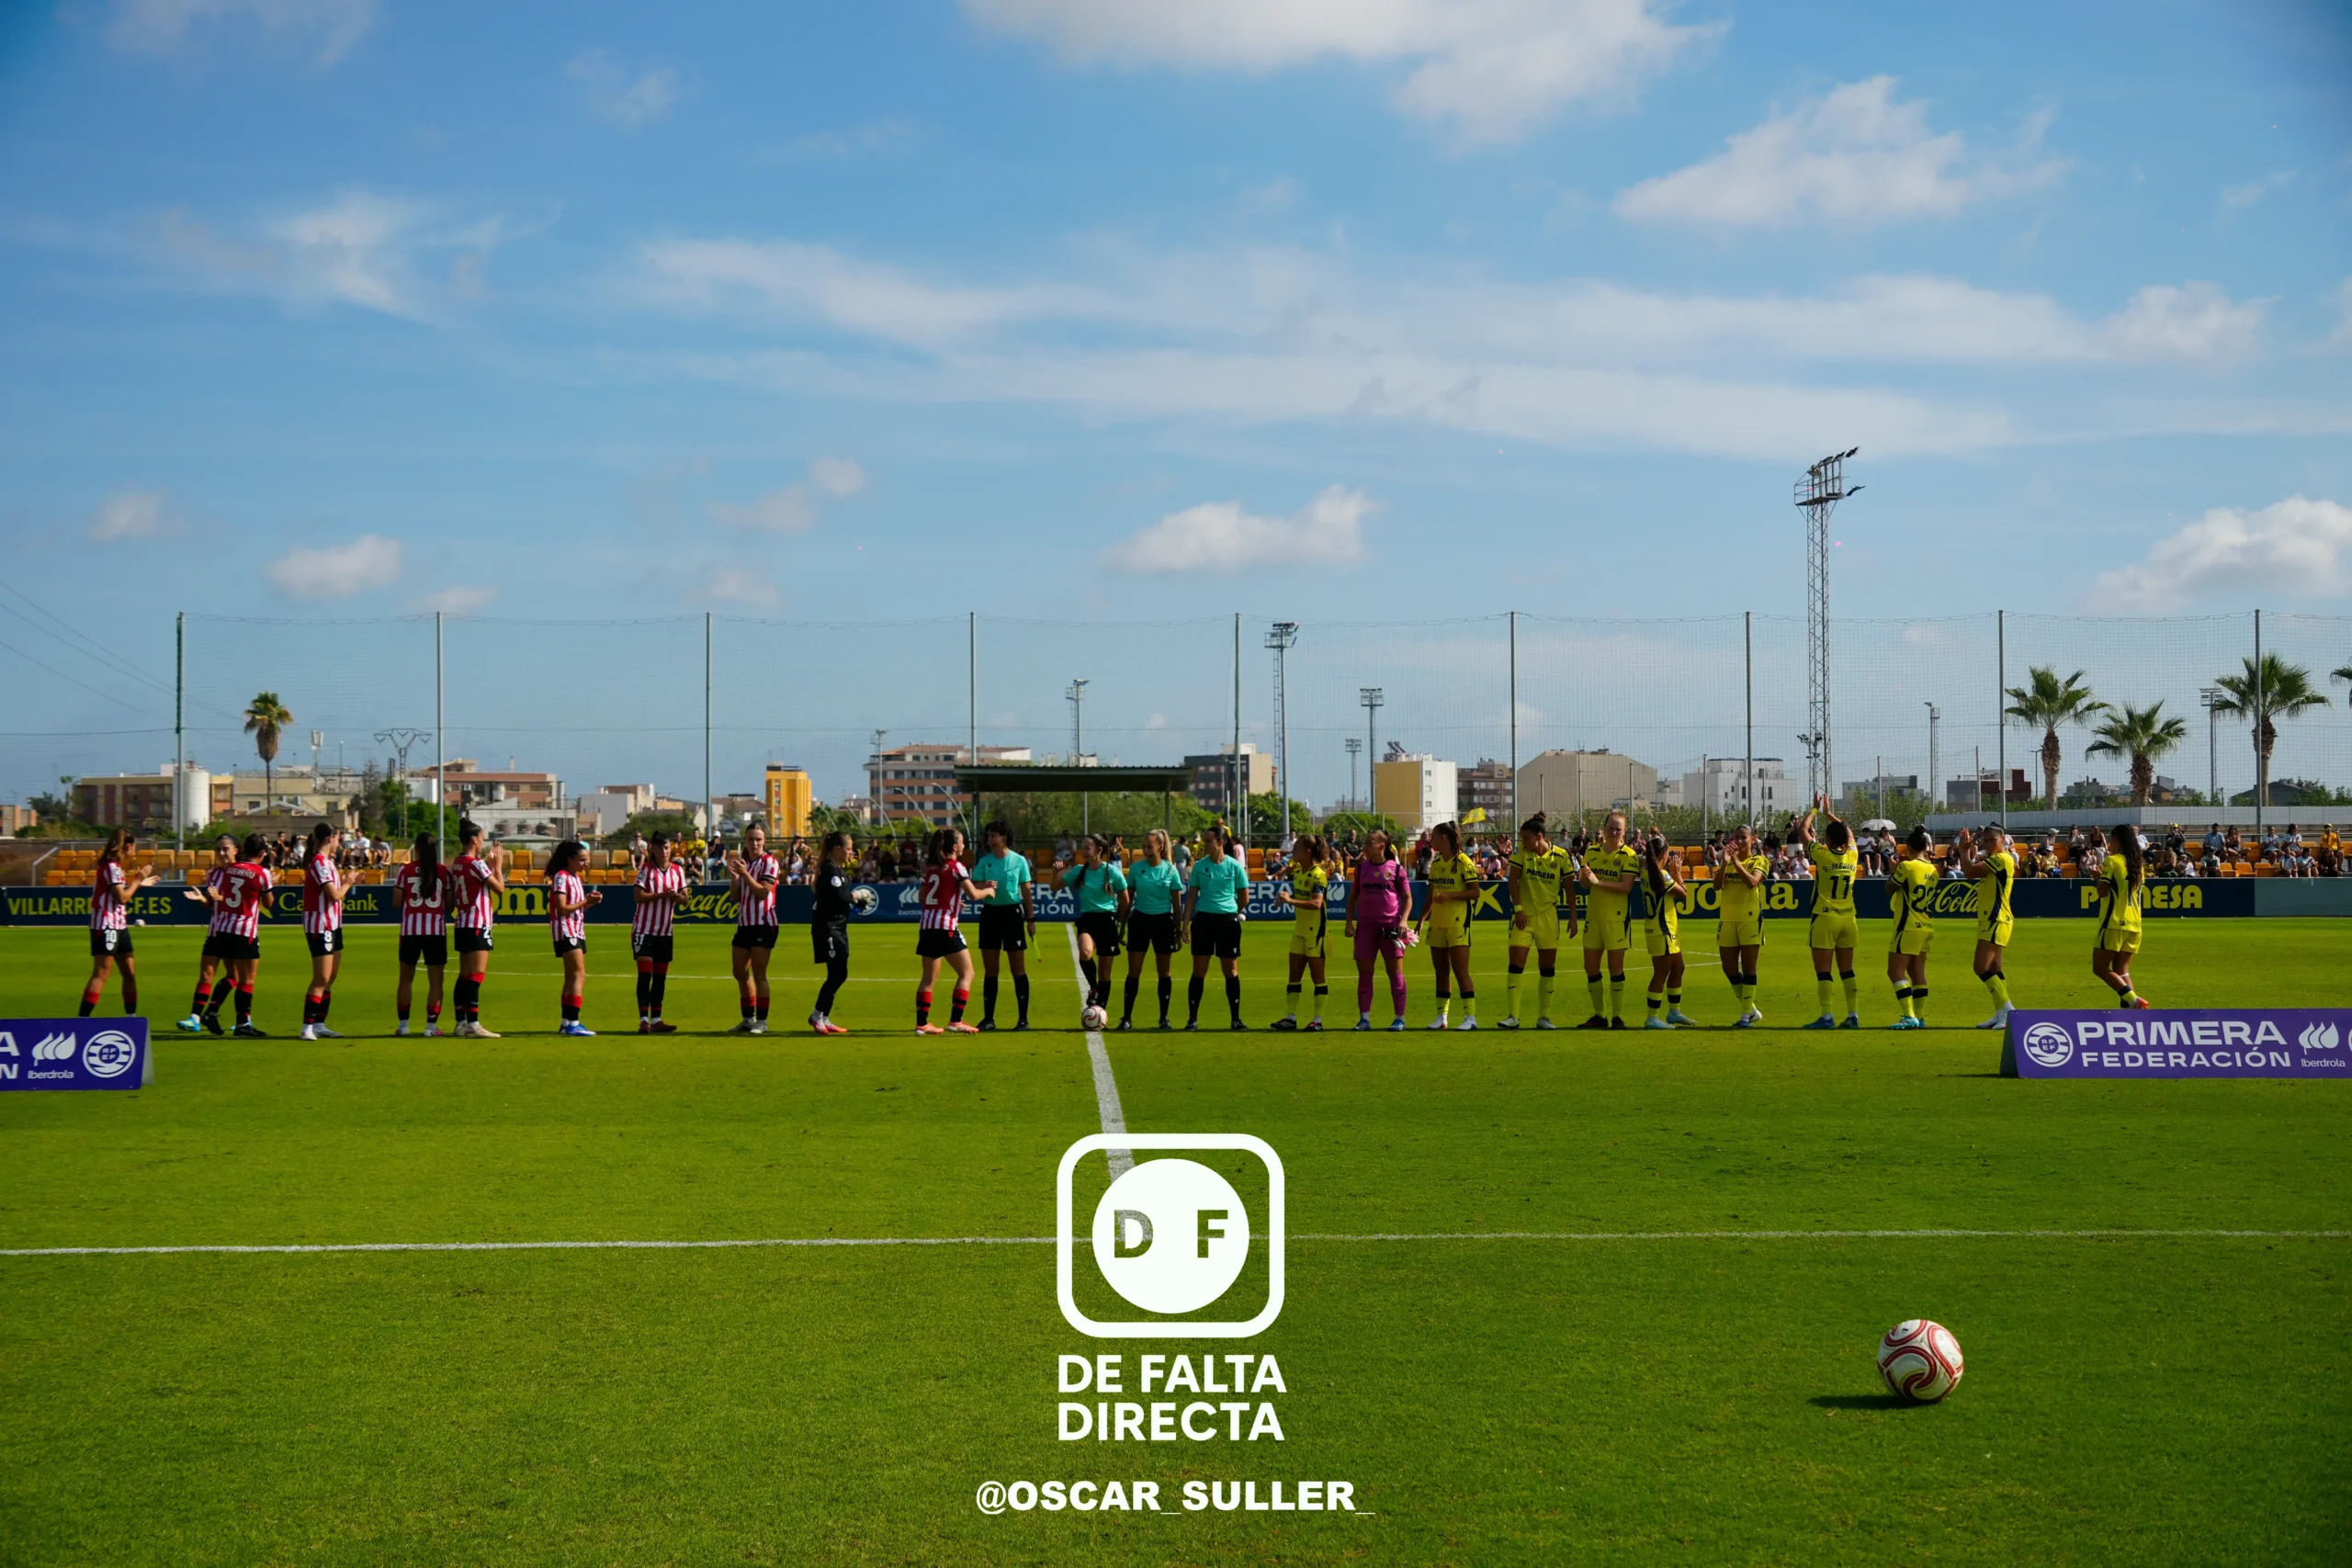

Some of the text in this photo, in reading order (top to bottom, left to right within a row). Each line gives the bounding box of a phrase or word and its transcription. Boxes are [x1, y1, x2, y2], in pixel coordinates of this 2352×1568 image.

[1526, 868, 1555, 879] PAMESA
[225, 877, 245, 908] 3
[407, 876, 443, 908] 30
[925, 874, 939, 905] 2
[1829, 875, 1851, 900] 11
[2081, 885, 2202, 909] PESA
[104, 930, 118, 943] 10
[324, 931, 333, 943] 8
[634, 933, 644, 945] 31
[828, 937, 834, 949] 1
[2076, 1021, 2287, 1046] PRIMERA
[2081, 1047, 2291, 1067] FEDERACIÓN
[2301, 1058, 2346, 1067] Iberdrola
[28, 1070, 74, 1079] Iberdrola
